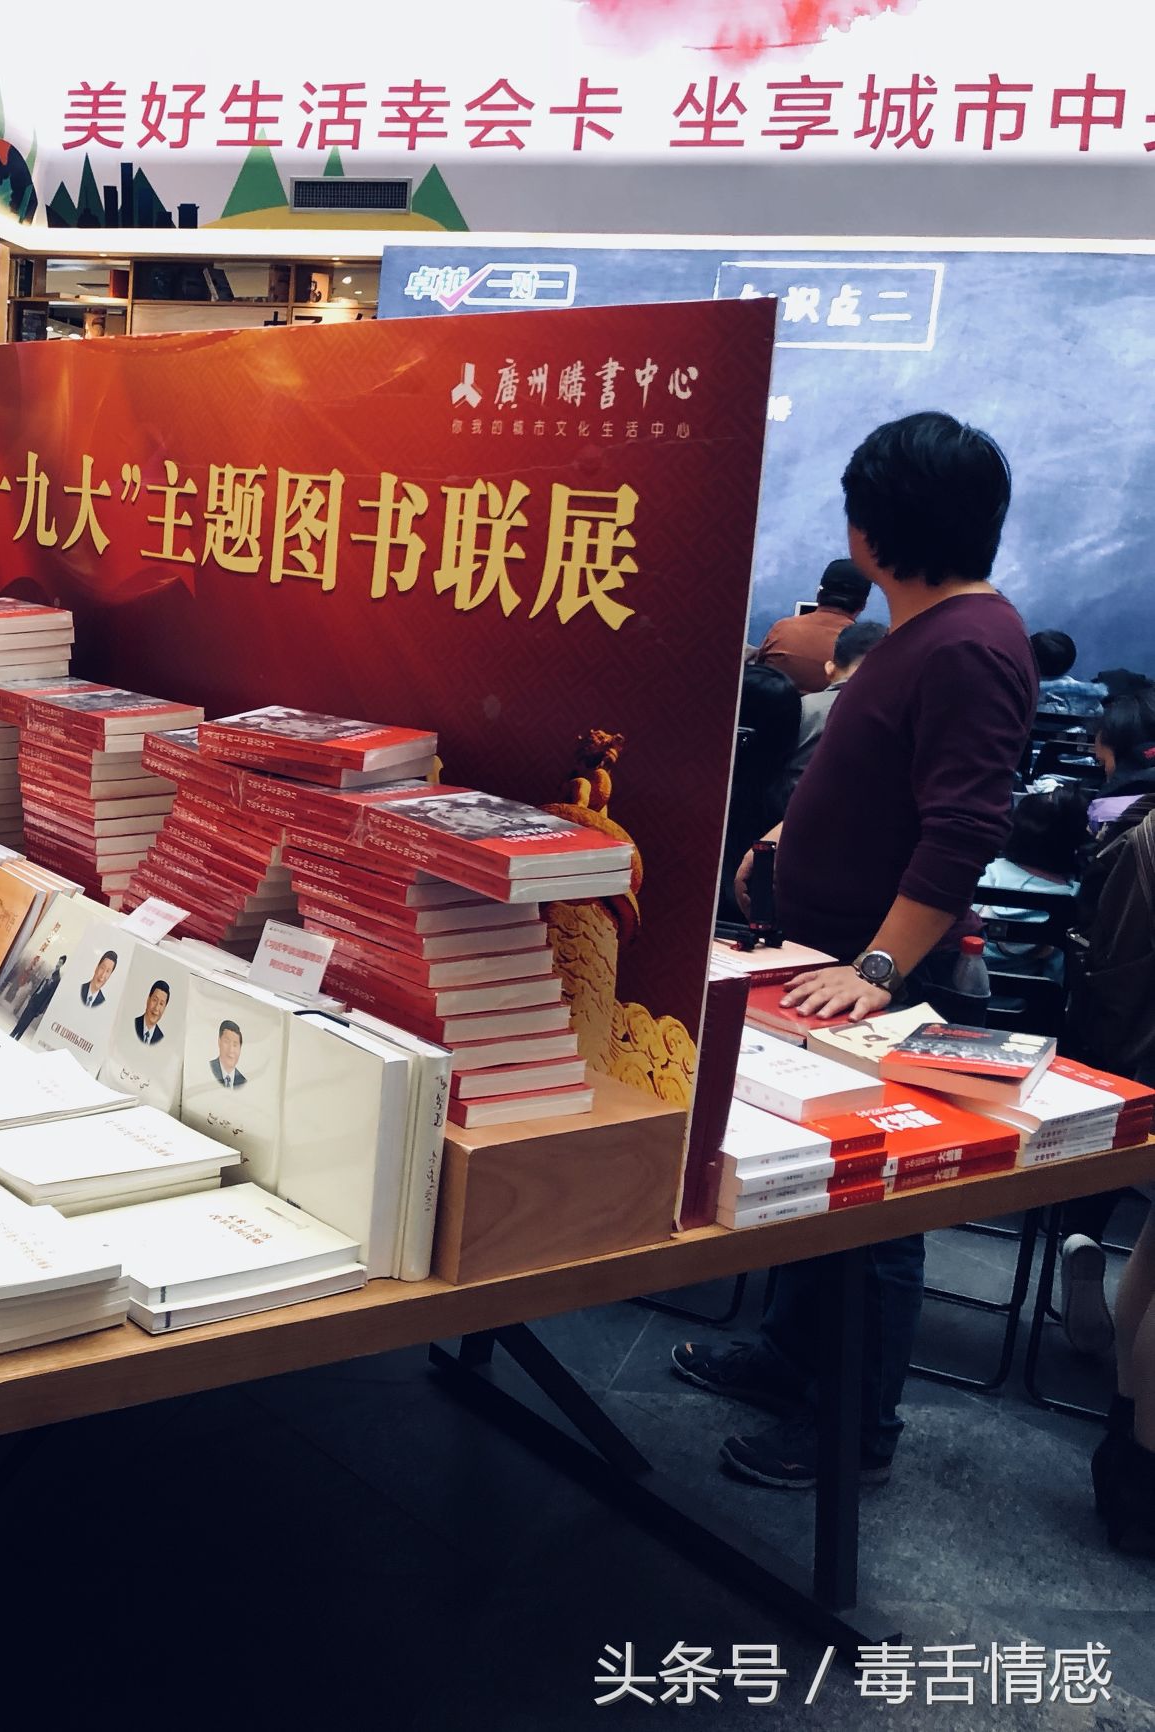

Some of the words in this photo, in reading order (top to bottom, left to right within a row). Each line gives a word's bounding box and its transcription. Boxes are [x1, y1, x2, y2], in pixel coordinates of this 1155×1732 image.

[62, 77, 623, 151] 美好生活幸会卡
[669, 73, 1155, 152] 坐享城市中
[739, 283, 913, 327] 识点二
[494, 357, 699, 411] 廣州購書中心
[451, 418, 691, 439] 你我的城市文化生活中心
